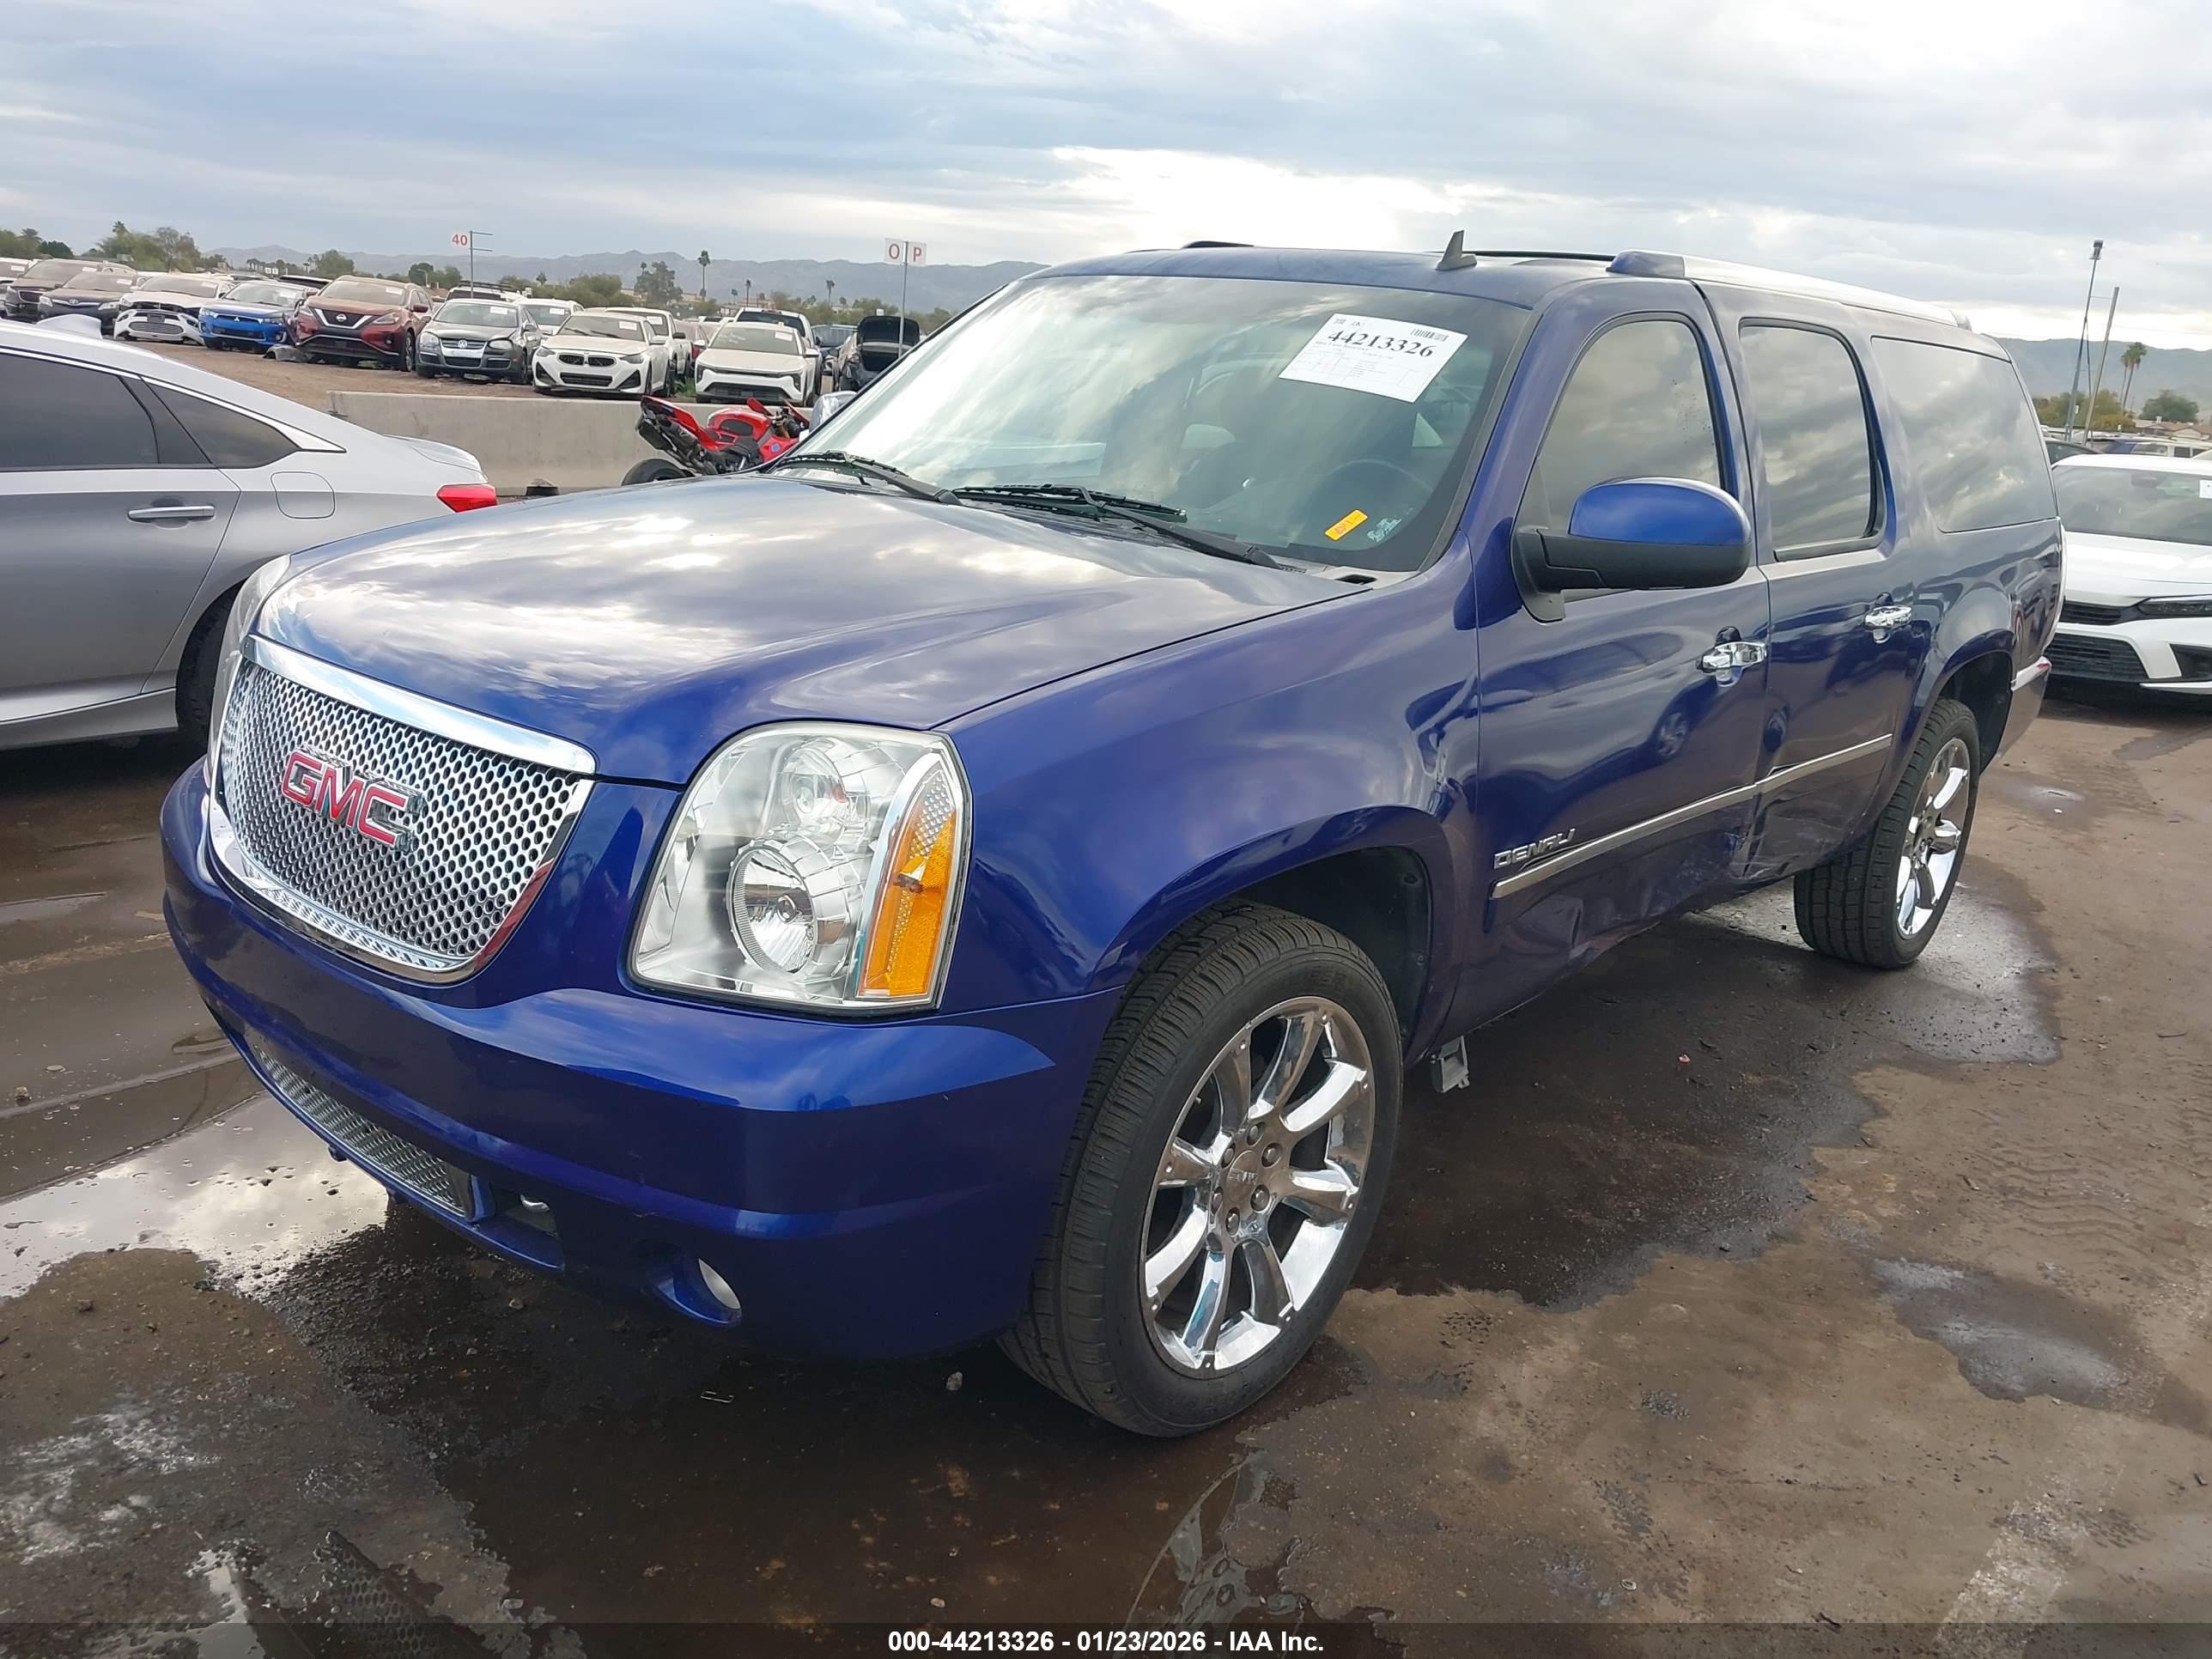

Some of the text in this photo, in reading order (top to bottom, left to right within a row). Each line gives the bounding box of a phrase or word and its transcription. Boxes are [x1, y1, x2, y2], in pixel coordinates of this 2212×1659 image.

[452, 234, 468, 246] 40
[889, 243, 900, 260] O
[913, 246, 922, 262] P
[1328, 330, 1437, 358] 44213326
[281, 750, 411, 848] GMC
[1493, 827, 1577, 870] DENALI
